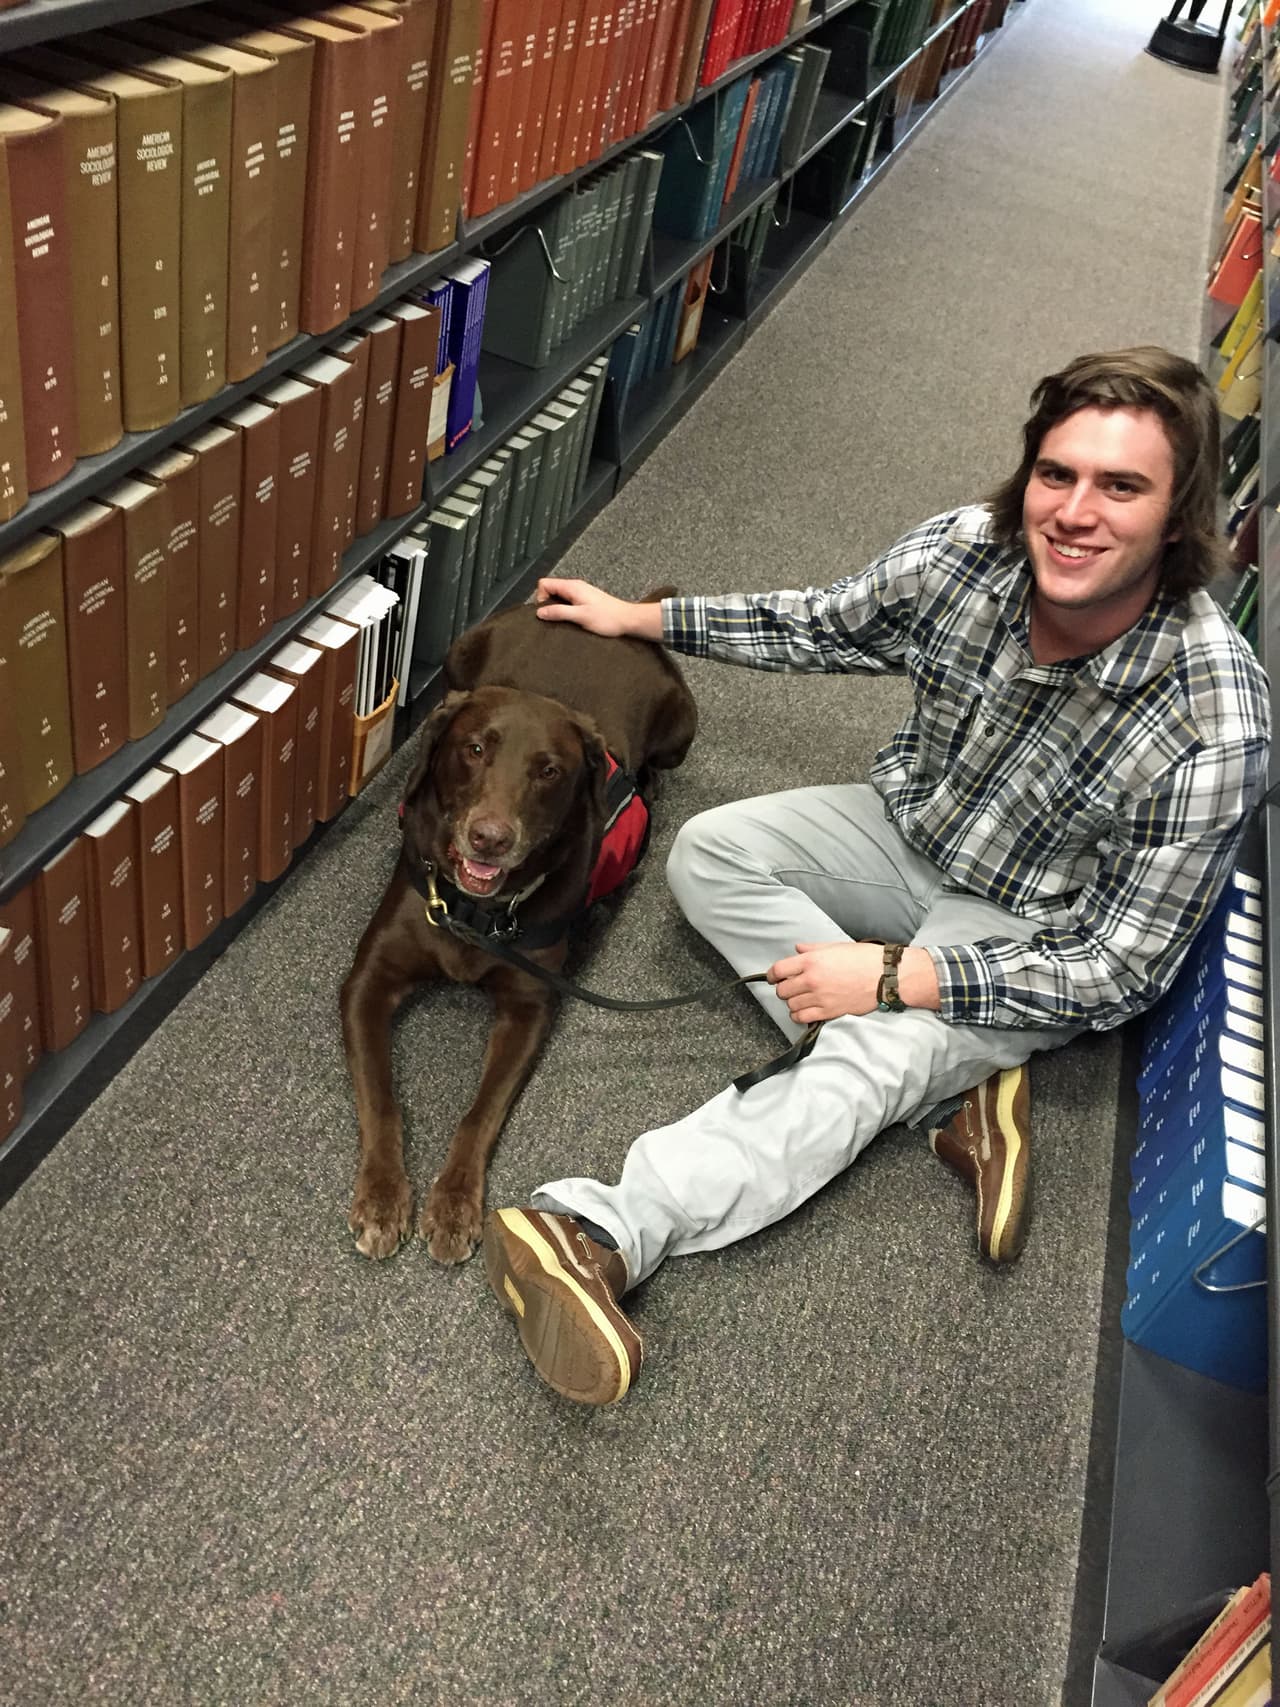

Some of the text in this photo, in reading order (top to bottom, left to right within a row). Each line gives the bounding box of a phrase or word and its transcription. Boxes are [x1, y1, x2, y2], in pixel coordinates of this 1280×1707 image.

[142, 130, 170, 146] AMERICAN
[146, 158, 167, 172] REVIEW
[91, 170, 111, 186] REVIEW
